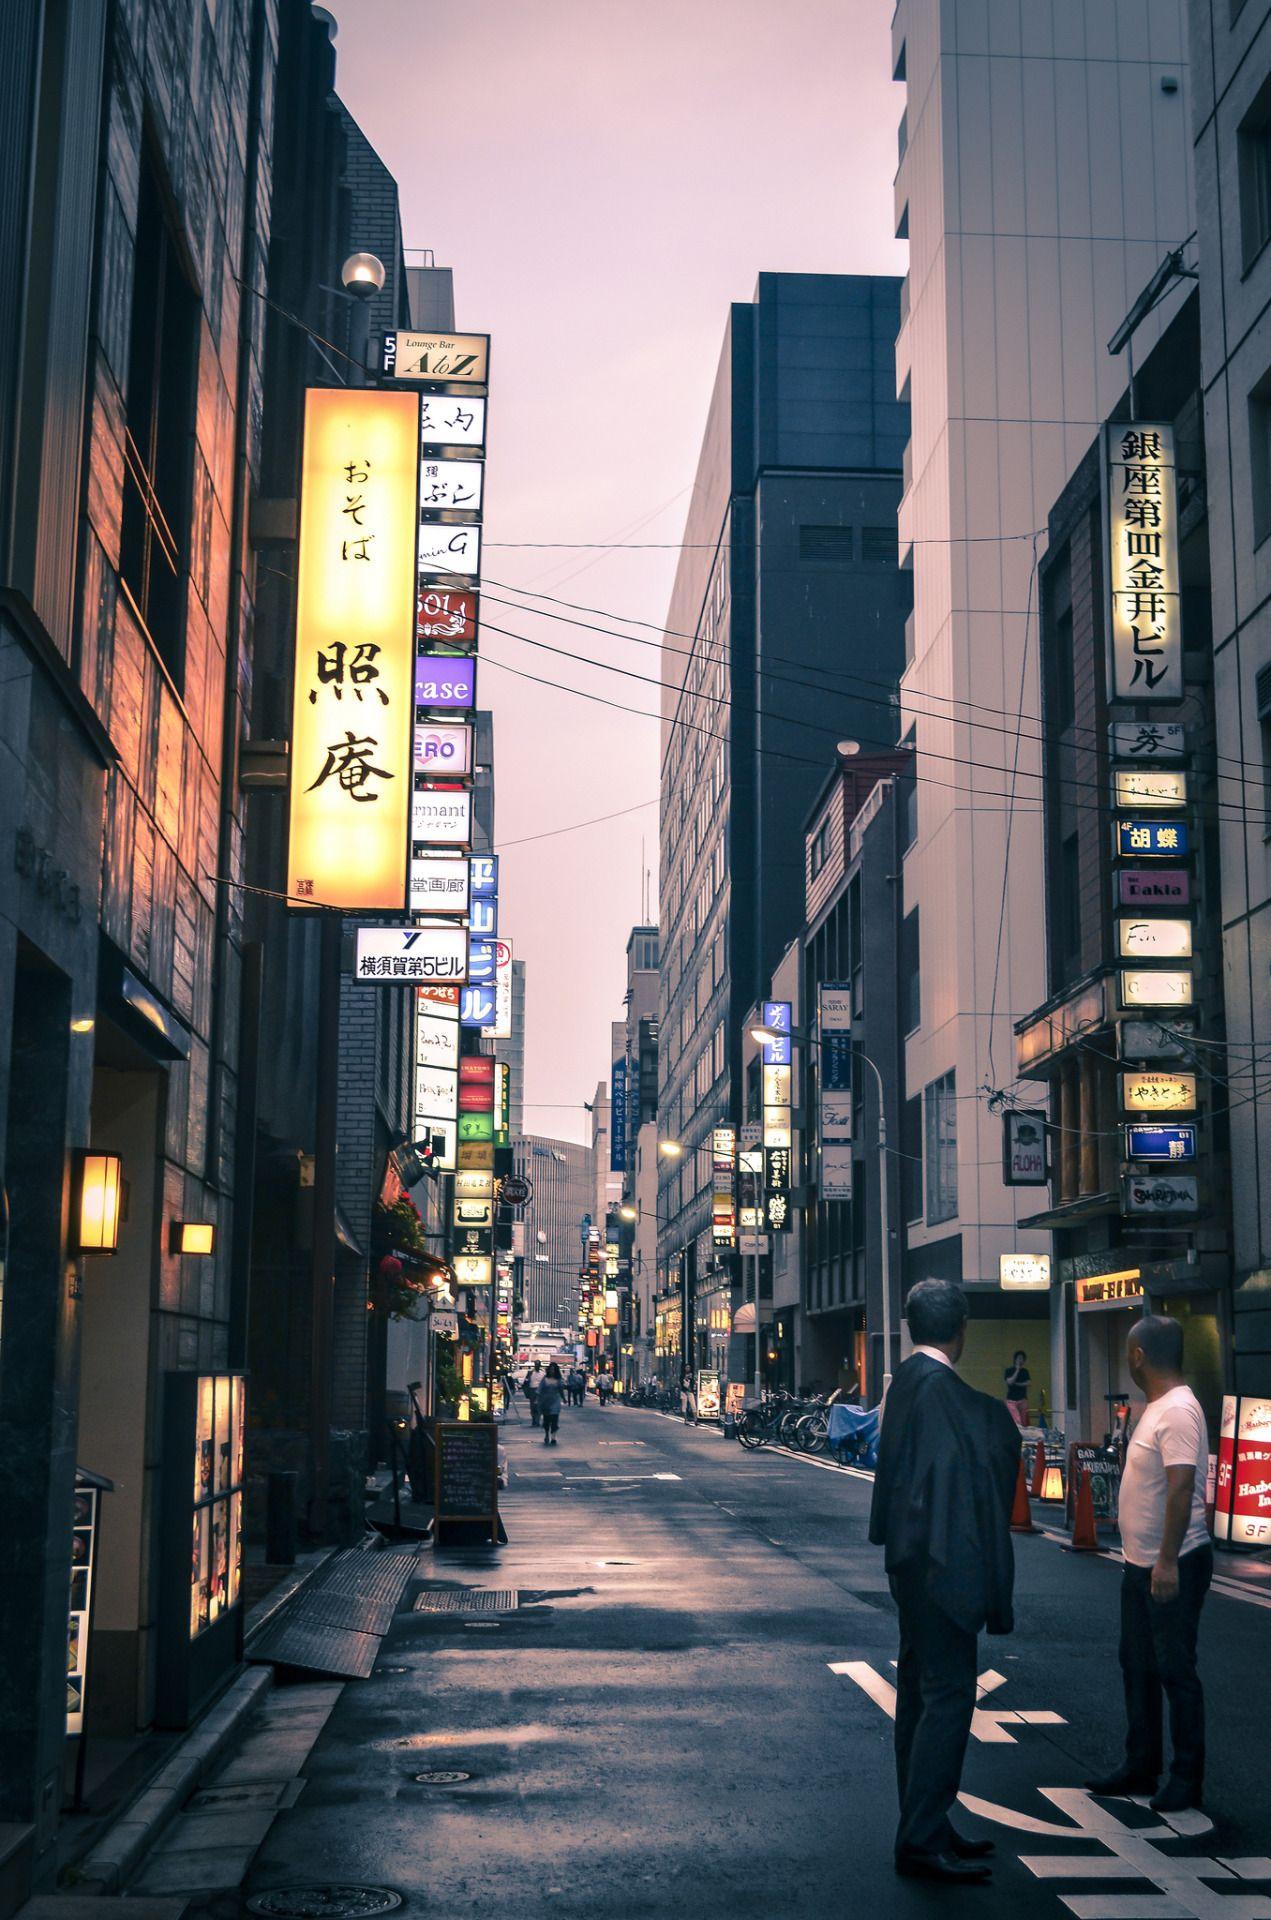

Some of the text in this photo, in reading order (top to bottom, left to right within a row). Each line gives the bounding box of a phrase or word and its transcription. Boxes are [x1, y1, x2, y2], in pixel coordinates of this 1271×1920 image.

[406, 339, 456, 350] Lounge Bar
[341, 460, 376, 562] おそば
[1120, 430, 1169, 690] 銀座第四金井ビル
[303, 641, 395, 803] 照庵
[1130, 828, 1178, 849] 胡蝶
[359, 956, 465, 977] 横須賀第5ビル
[1013, 1154, 1043, 1172] ALOHA
[1077, 1449, 1096, 1459] BAR
